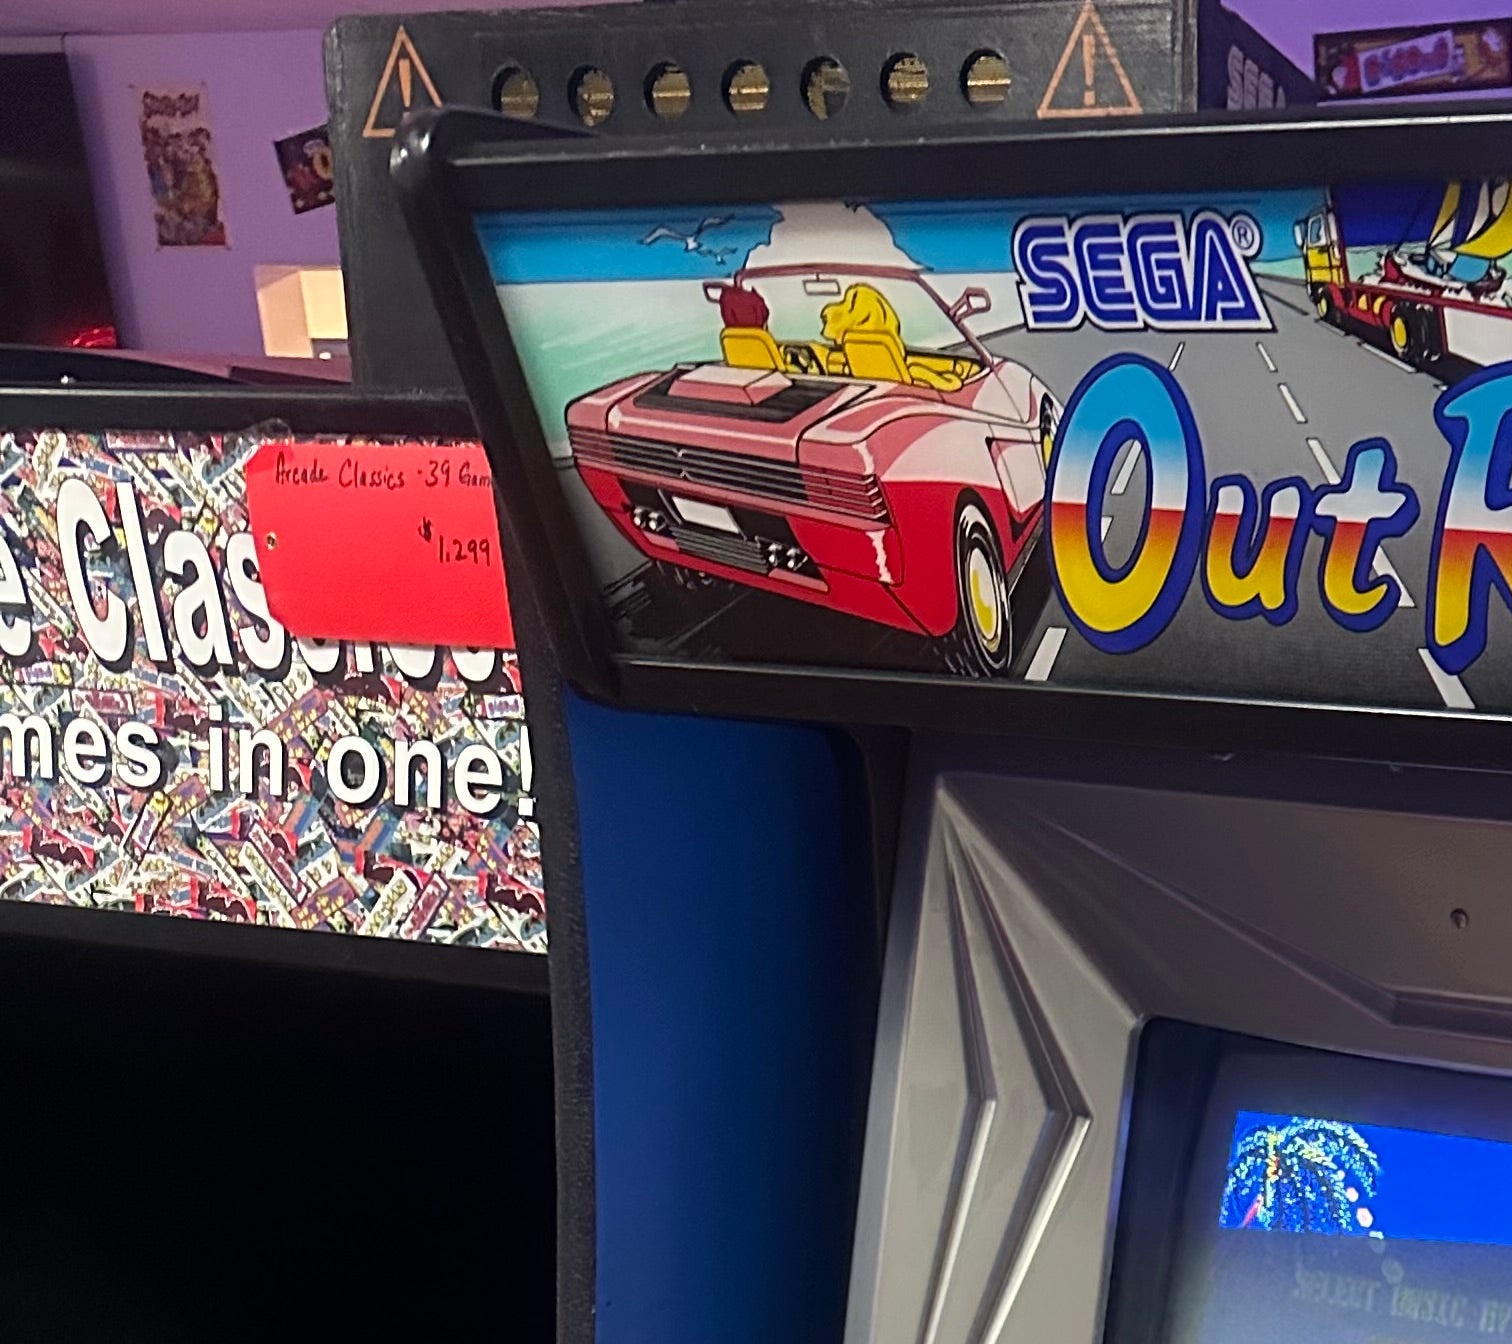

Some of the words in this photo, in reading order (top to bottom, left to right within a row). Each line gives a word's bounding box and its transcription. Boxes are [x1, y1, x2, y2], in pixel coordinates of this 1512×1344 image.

[1227, 44, 1286, 110] SEG
[276, 451, 328, 485] Arcade
[338, 458, 405, 490] Classics
[208, 704, 285, 796] in
[327, 725, 535, 817] one!
